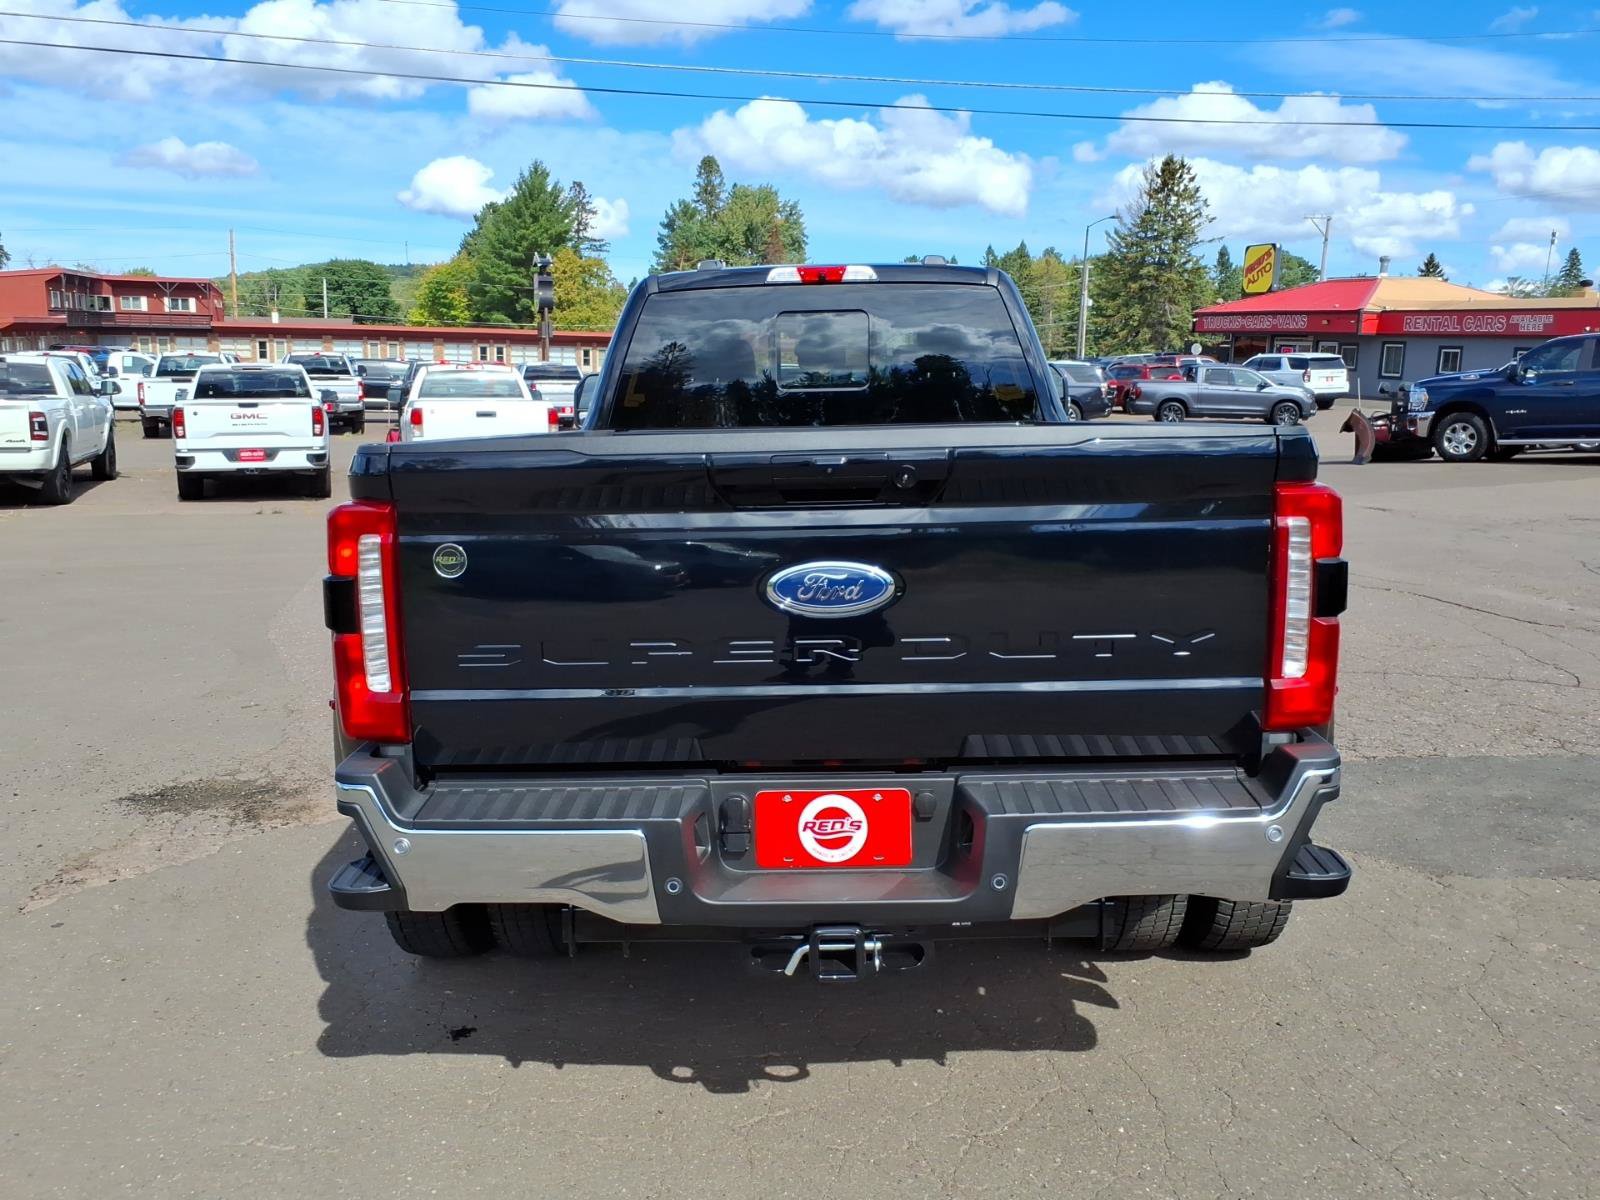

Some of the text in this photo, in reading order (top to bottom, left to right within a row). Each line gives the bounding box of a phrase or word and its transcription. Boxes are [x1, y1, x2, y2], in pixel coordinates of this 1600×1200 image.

[1246, 262, 1272, 289] AUTO
[1403, 316, 1506, 332] RENTAL CARS
[1510, 315, 1554, 323] AVAILABLE
[1519, 323, 1543, 332] HERE
[797, 573, 864, 601] Ford
[458, 629, 1217, 667] SUPER DUTY
[802, 818, 863, 836] RED'S
